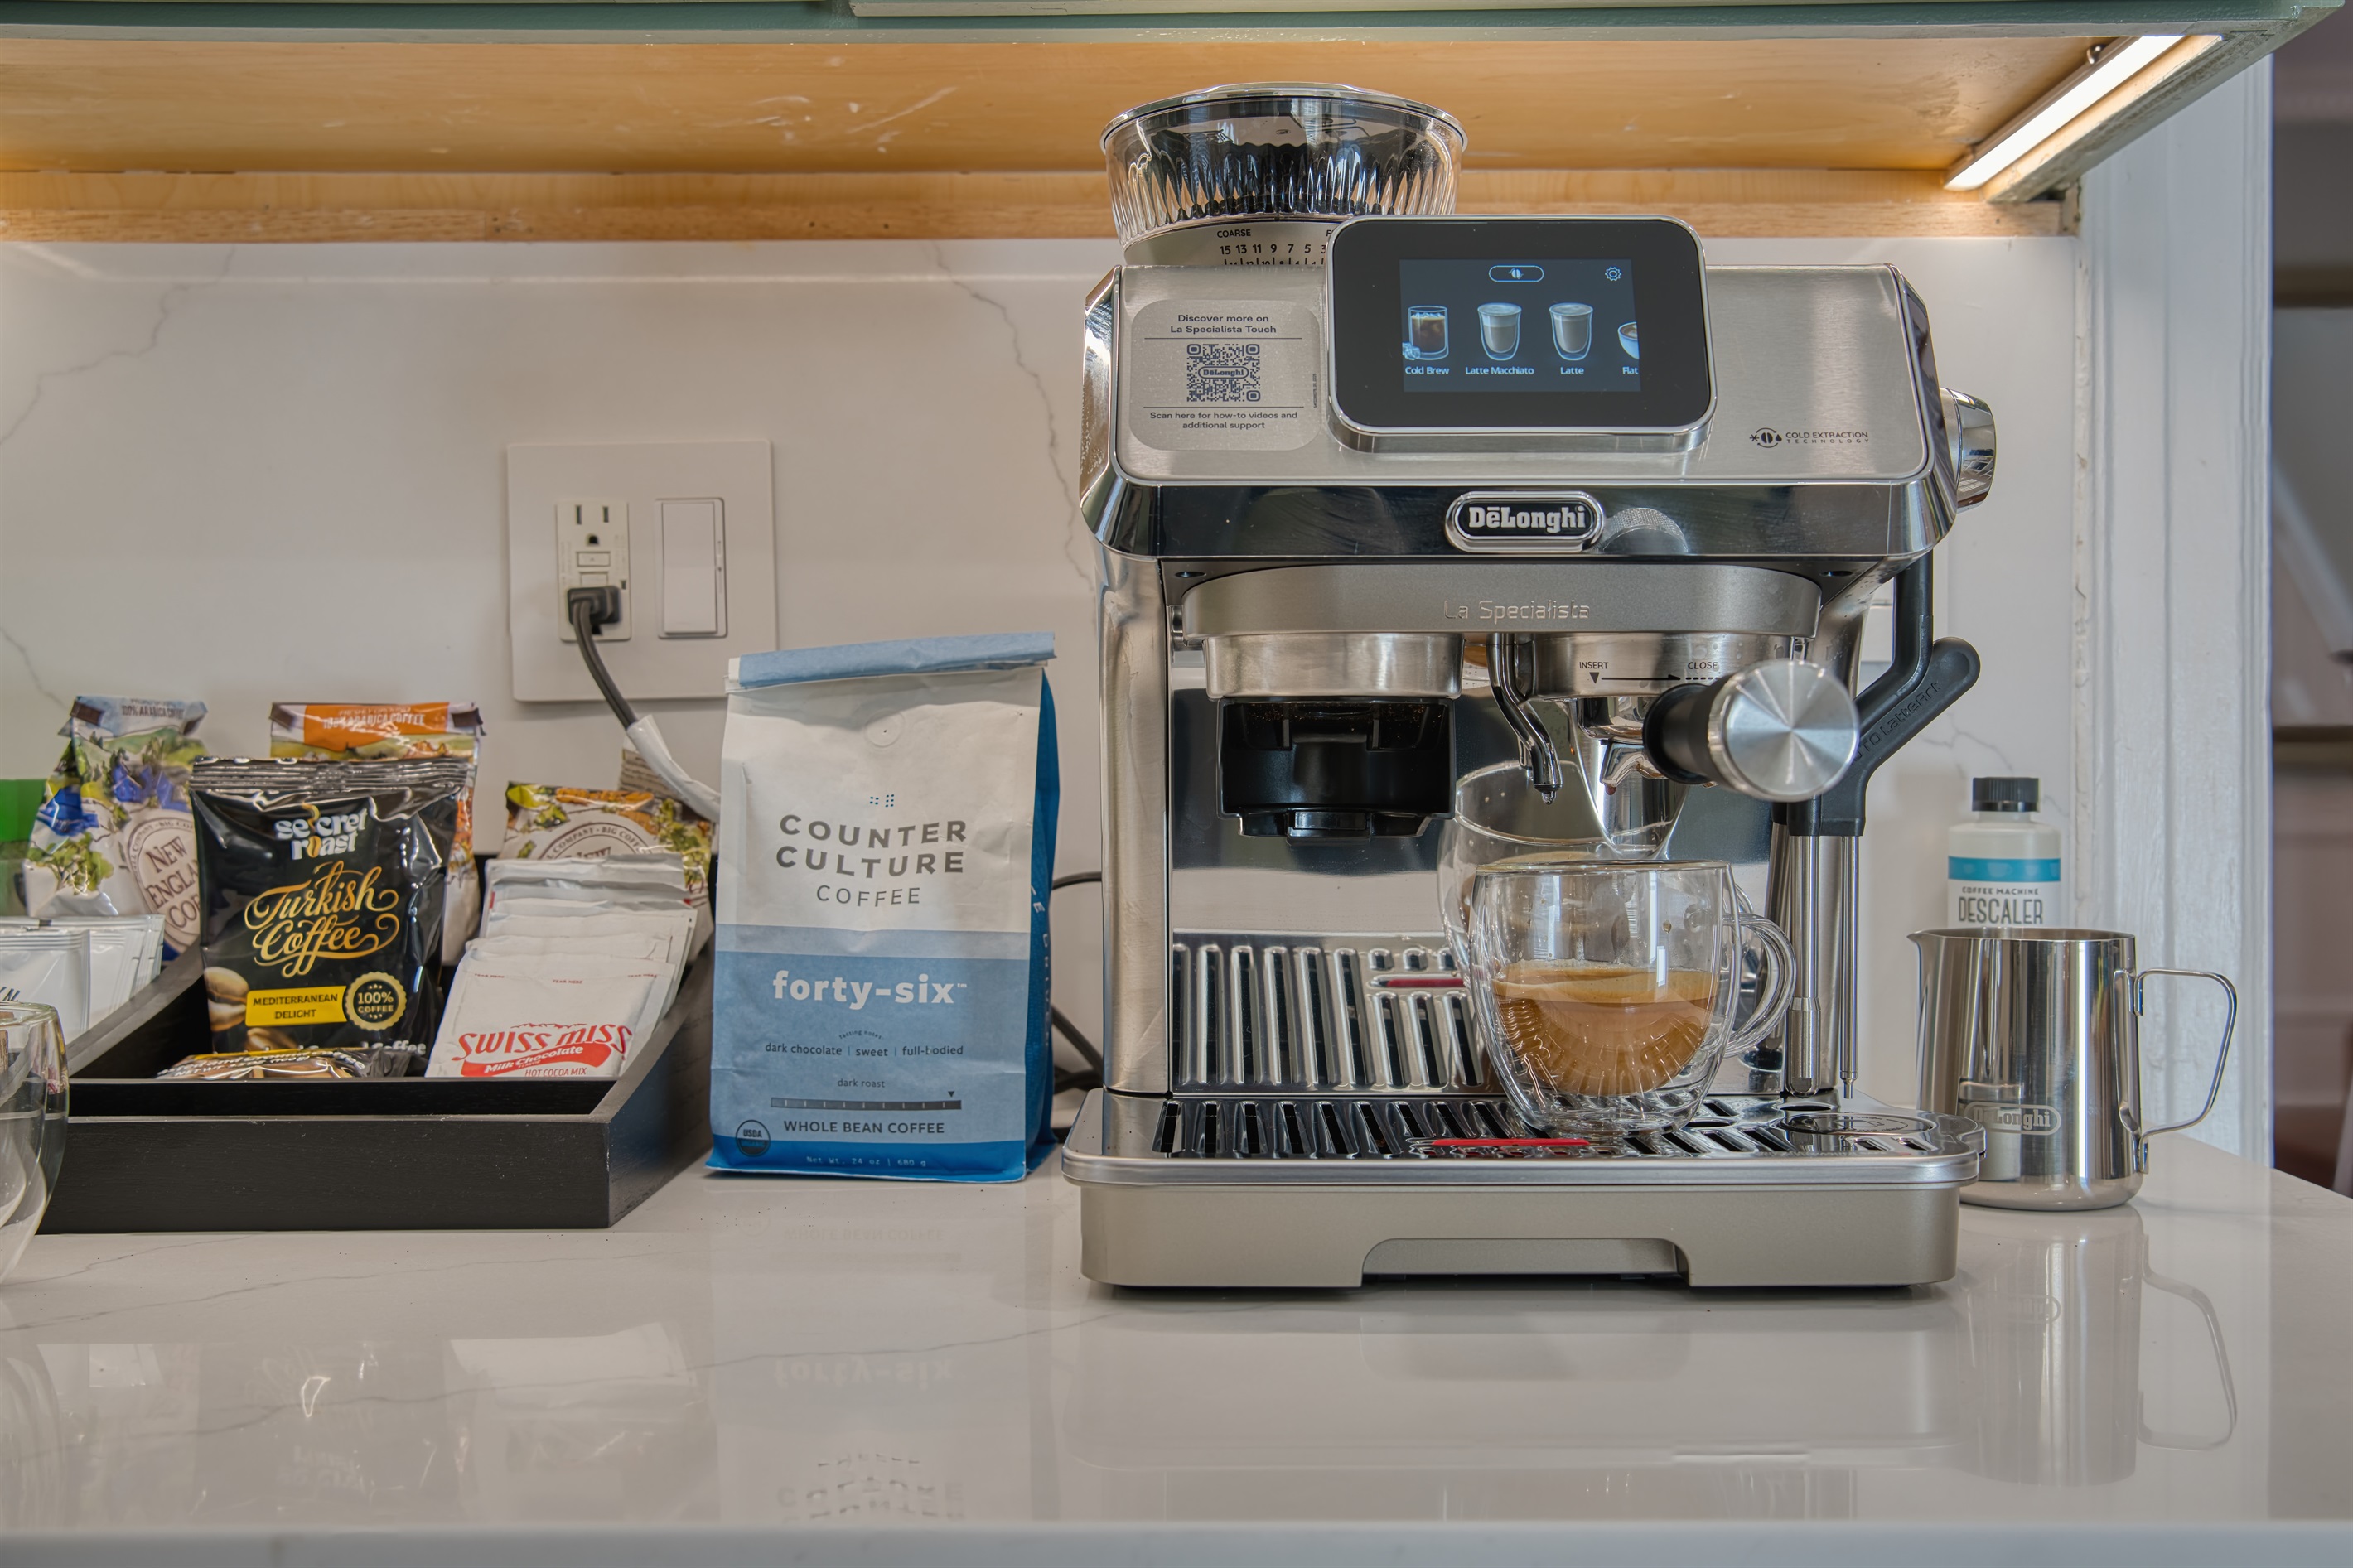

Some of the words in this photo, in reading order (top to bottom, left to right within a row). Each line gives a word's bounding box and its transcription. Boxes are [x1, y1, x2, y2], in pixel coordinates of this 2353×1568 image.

[1216, 229, 1251, 239] COARSE
[1220, 245, 1231, 255] 15
[1235, 244, 1247, 254] 13
[1252, 244, 1262, 253] 11
[1270, 244, 1278, 253] 9
[1288, 244, 1294, 253] 7
[1304, 244, 1312, 253] 5
[1177, 314, 1224, 323] Discover
[1186, 325, 1243, 335] Specialista
[1245, 325, 1277, 333] Touch
[1404, 366, 1424, 375] Cold
[1426, 366, 1449, 375] Brew
[1465, 366, 1489, 375] Latte
[1491, 366, 1534, 375] Macchiato
[1560, 366, 1584, 375] Latte
[1622, 366, 1639, 374] Flat
[1182, 421, 1227, 429] additional
[1230, 422, 1265, 430] support
[1443, 600, 1469, 620] La
[1479, 600, 1590, 625] Specialista
[1579, 661, 1609, 669] INSERT
[1688, 661, 1718, 670] CLOSE
[273, 808, 368, 840] secret
[780, 814, 967, 849] COUNTER
[291, 831, 359, 860] roast
[553, 827, 593, 853] COMPANY
[602, 827, 617, 835] BIG
[146, 836, 187, 873] NEW
[776, 845, 964, 879] CULTURE
[145, 859, 199, 909] ENGLA
[1962, 886, 1993, 895] COFFEE
[1996, 887, 2039, 895] MACHINE
[244, 861, 399, 929] Turkish
[816, 885, 920, 907] COFFEE
[1958, 896, 2043, 924] DESCALER
[252, 914, 399, 977] Coffee
[772, 970, 954, 1011] forty-six
[253, 993, 338, 1006] MEDITERRANEAN
[357, 991, 394, 1005] 100%
[274, 1009, 316, 1020] DELIGHT
[358, 1005, 394, 1013] COFFEE
[451, 1031, 552, 1061] SWISS
[765, 1042, 788, 1053] dark
[790, 1044, 843, 1055] chocolate
[856, 1047, 888, 1057] sweet
[902, 1045, 964, 1056] full-bodied
[483, 1061, 515, 1074] Milk
[515, 1046, 584, 1065] Chocolate
[525, 1069, 543, 1077] HOT
[543, 1069, 569, 1077] COCOA
[570, 1067, 587, 1076] MIX
[837, 1078, 858, 1088] dark
[861, 1079, 886, 1088] roast
[743, 1128, 762, 1138] USDA
[783, 1120, 838, 1133] WHOLE
[843, 1122, 882, 1134] BEAN
[887, 1122, 945, 1134] COFFEE
